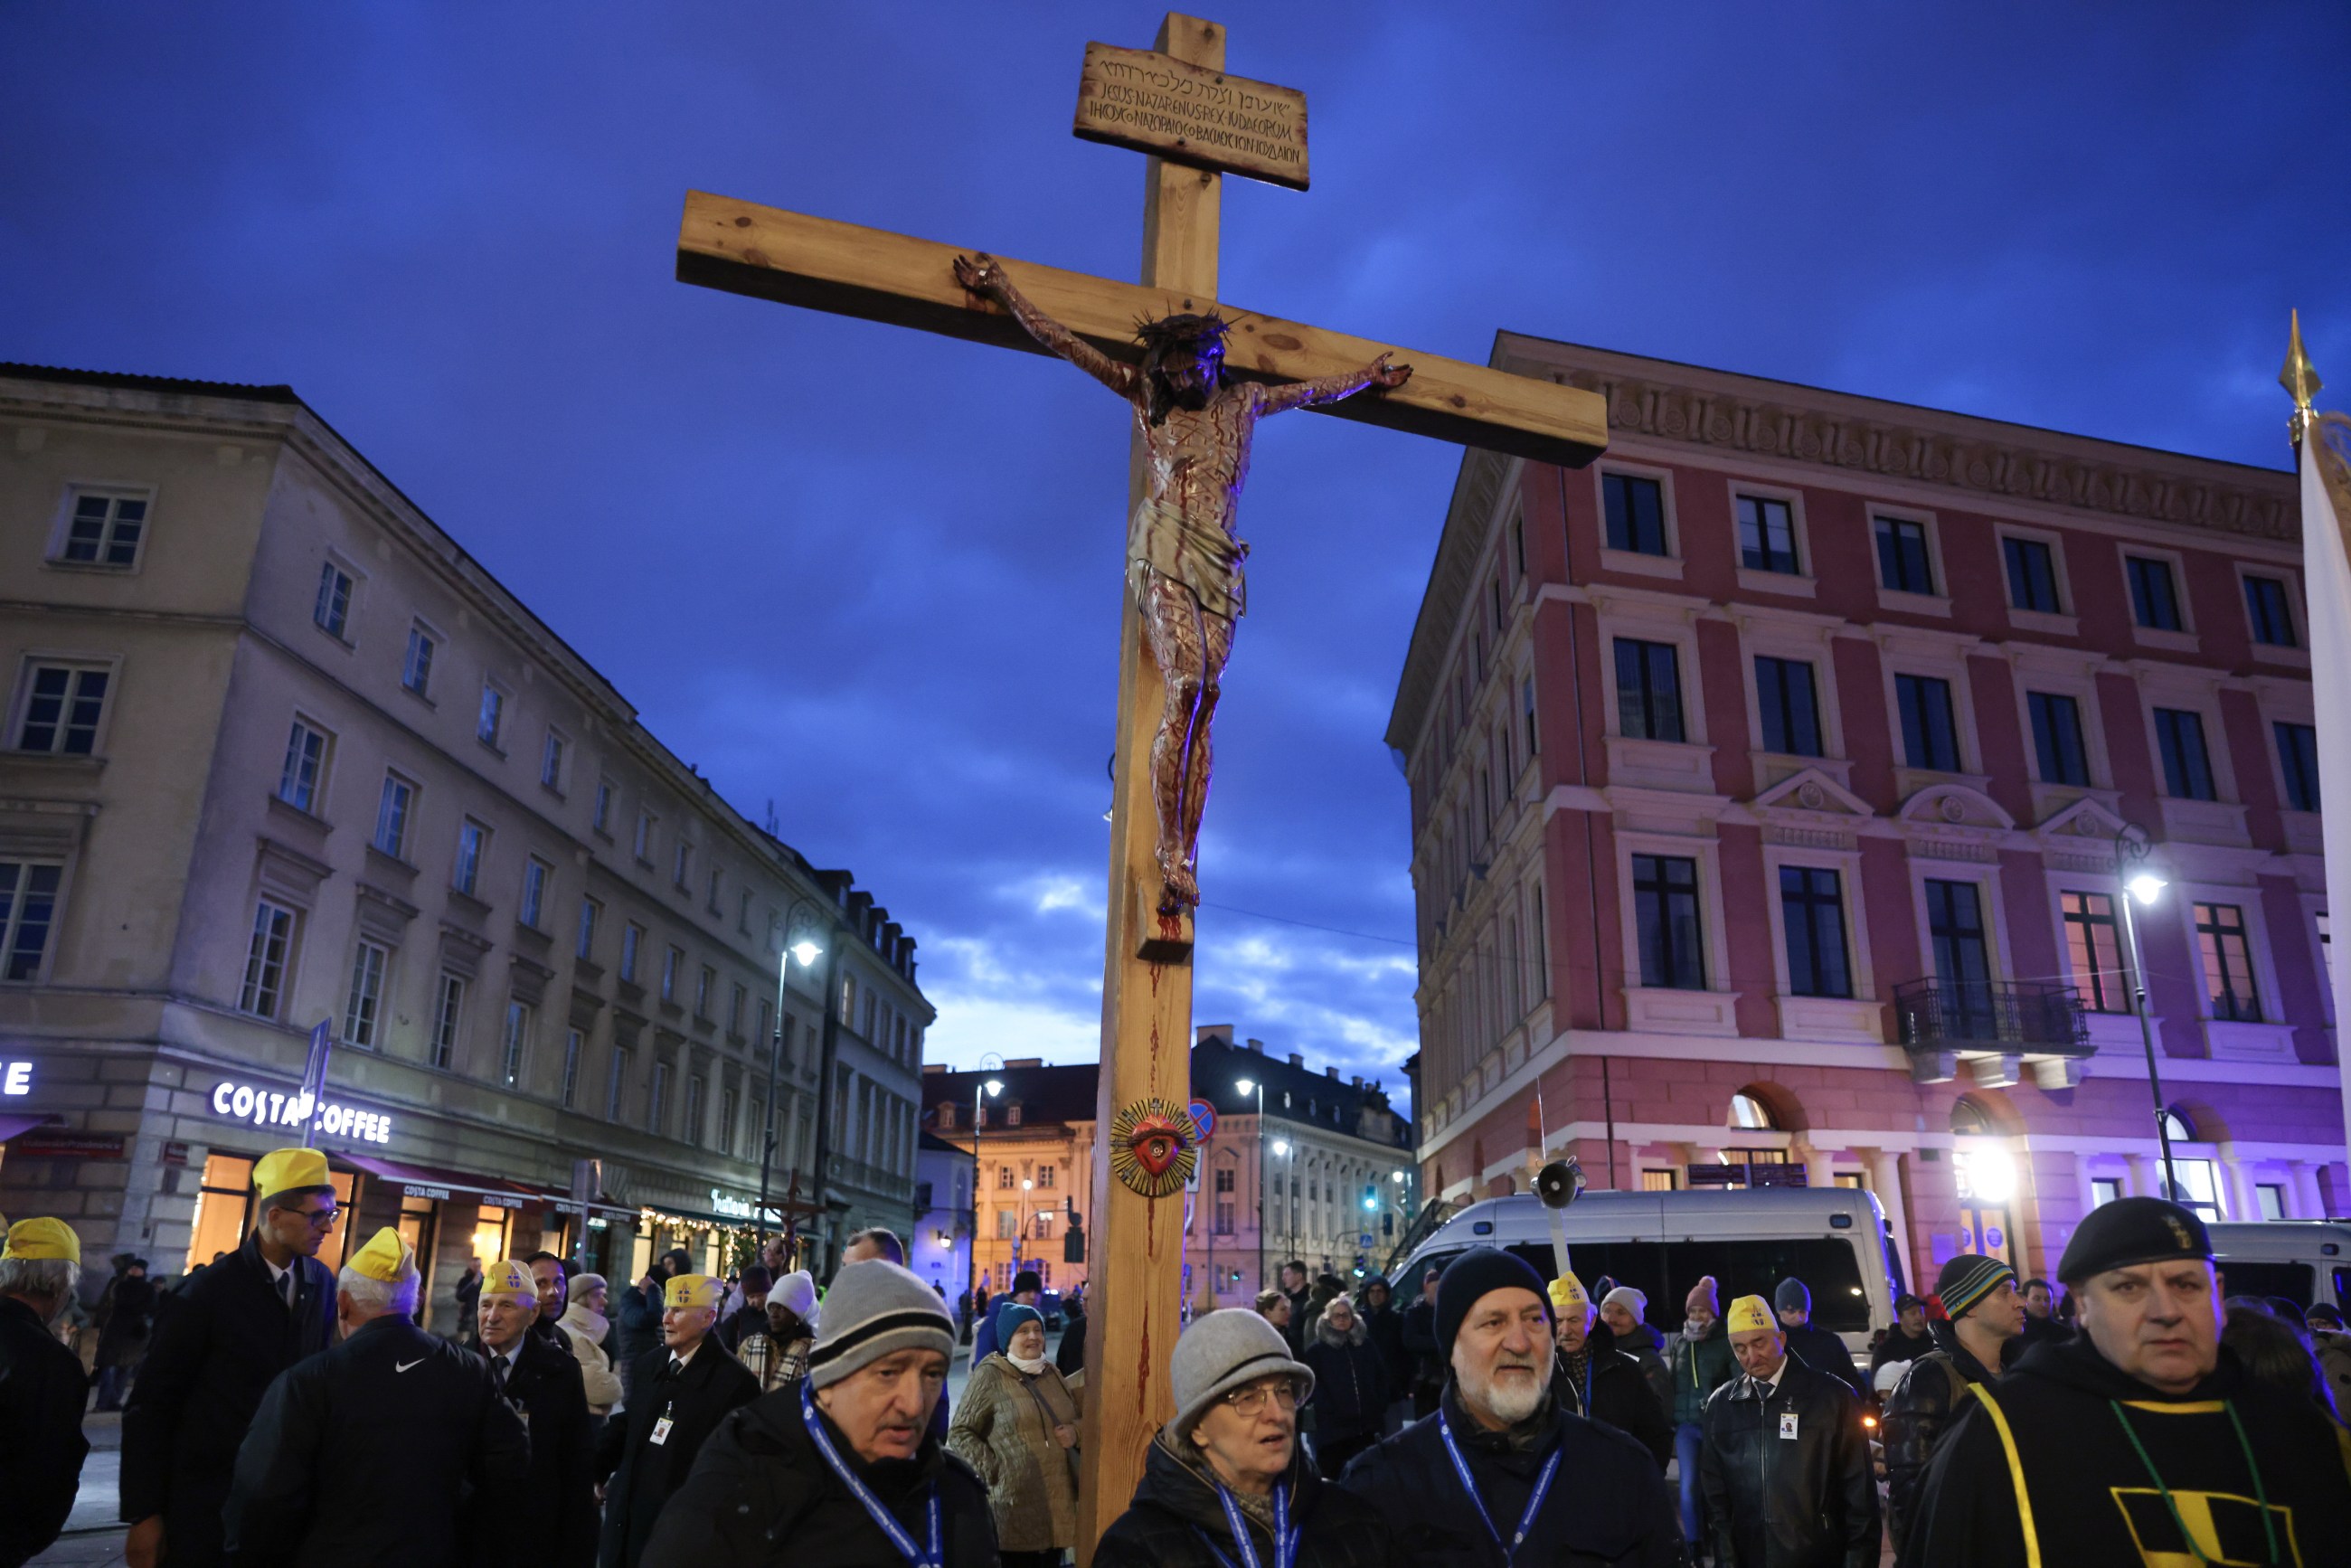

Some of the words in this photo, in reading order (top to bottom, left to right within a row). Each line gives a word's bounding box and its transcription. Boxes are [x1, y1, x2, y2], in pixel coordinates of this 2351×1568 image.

[213, 1082, 300, 1127] COSTA
[404, 1185, 426, 1197] COSTA
[426, 1187, 450, 1200] COFFEE
